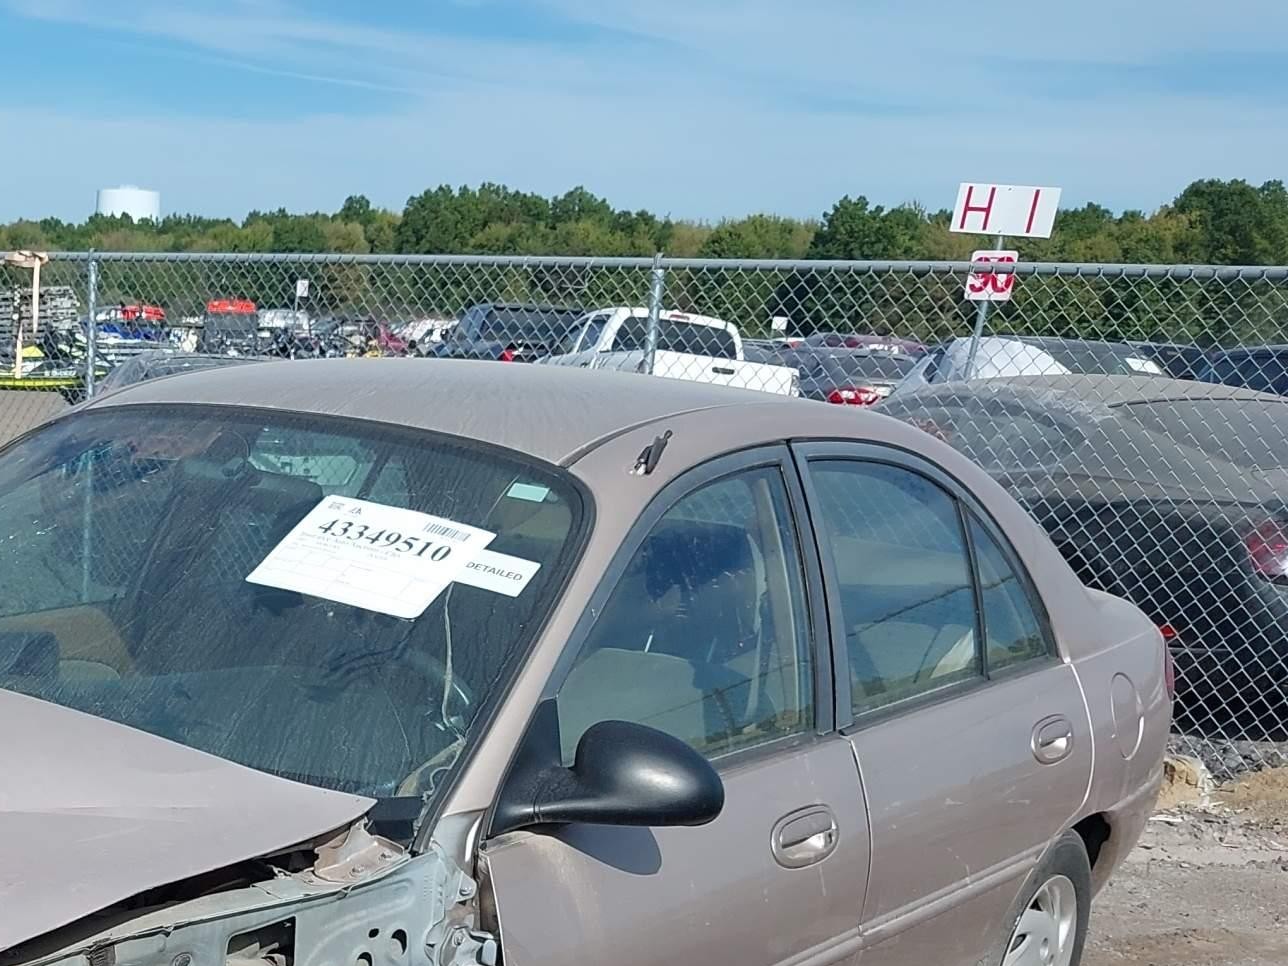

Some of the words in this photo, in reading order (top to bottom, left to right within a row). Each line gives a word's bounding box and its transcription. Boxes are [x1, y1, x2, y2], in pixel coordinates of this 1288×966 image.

[959, 186, 997, 231] H
[318, 518, 452, 562] 43349510
[465, 561, 523, 582] DETAILED
